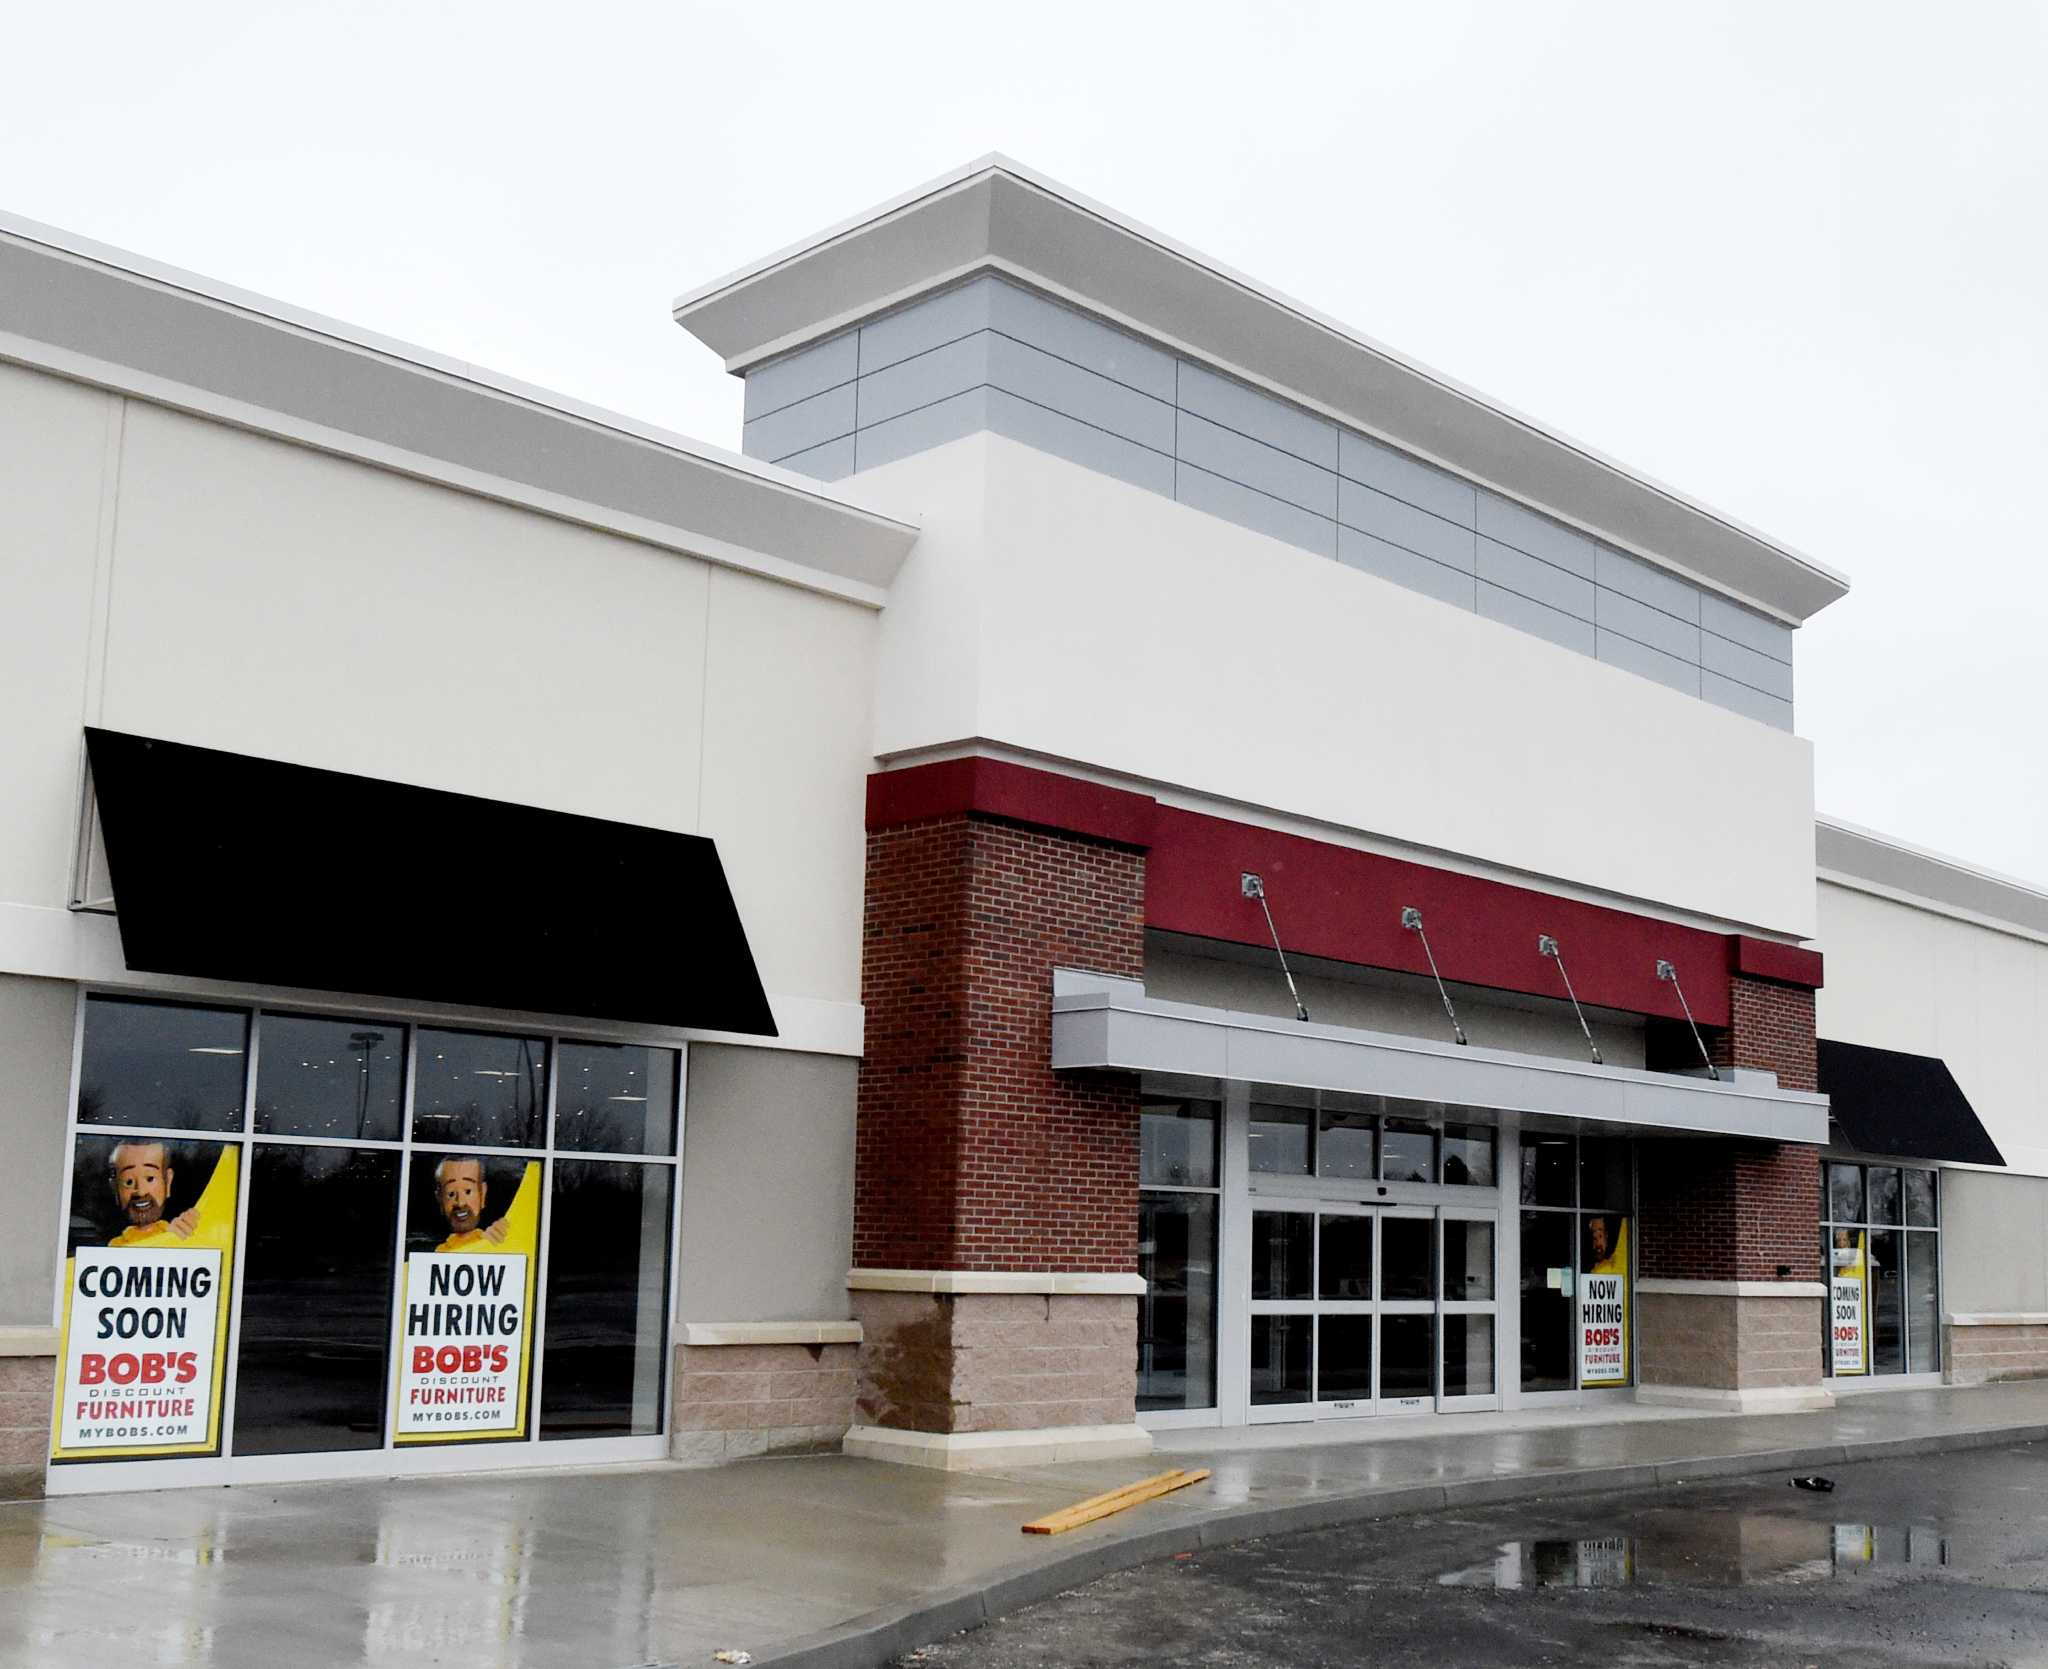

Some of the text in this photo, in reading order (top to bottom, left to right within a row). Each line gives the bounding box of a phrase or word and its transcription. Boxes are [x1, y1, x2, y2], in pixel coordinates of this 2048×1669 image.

[78, 1265, 212, 1298] COMING
[429, 1264, 506, 1297] NOW
[1589, 1280, 1617, 1299] NOW
[1833, 1286, 1860, 1301] COMING
[408, 1304, 518, 1336] HIRING
[1582, 1304, 1622, 1323] HIRING
[1836, 1305, 1857, 1320] SOON
[97, 1307, 187, 1339] SOON
[1585, 1328, 1620, 1346] BOB'S
[1834, 1327, 1859, 1341] BOB'S
[412, 1344, 509, 1374] BOB'S
[1585, 1353, 1620, 1364] FURNITURE
[79, 1352, 198, 1385] BOB'S
[420, 1375, 499, 1385] DISCOUNT
[89, 1387, 186, 1398] DISCOUNT
[410, 1387, 506, 1405] FURNITURE
[76, 1399, 195, 1420] FURNITURE
[412, 1410, 501, 1422] MYBOBS.COM
[79, 1425, 188, 1439] MYBOBS.COM
